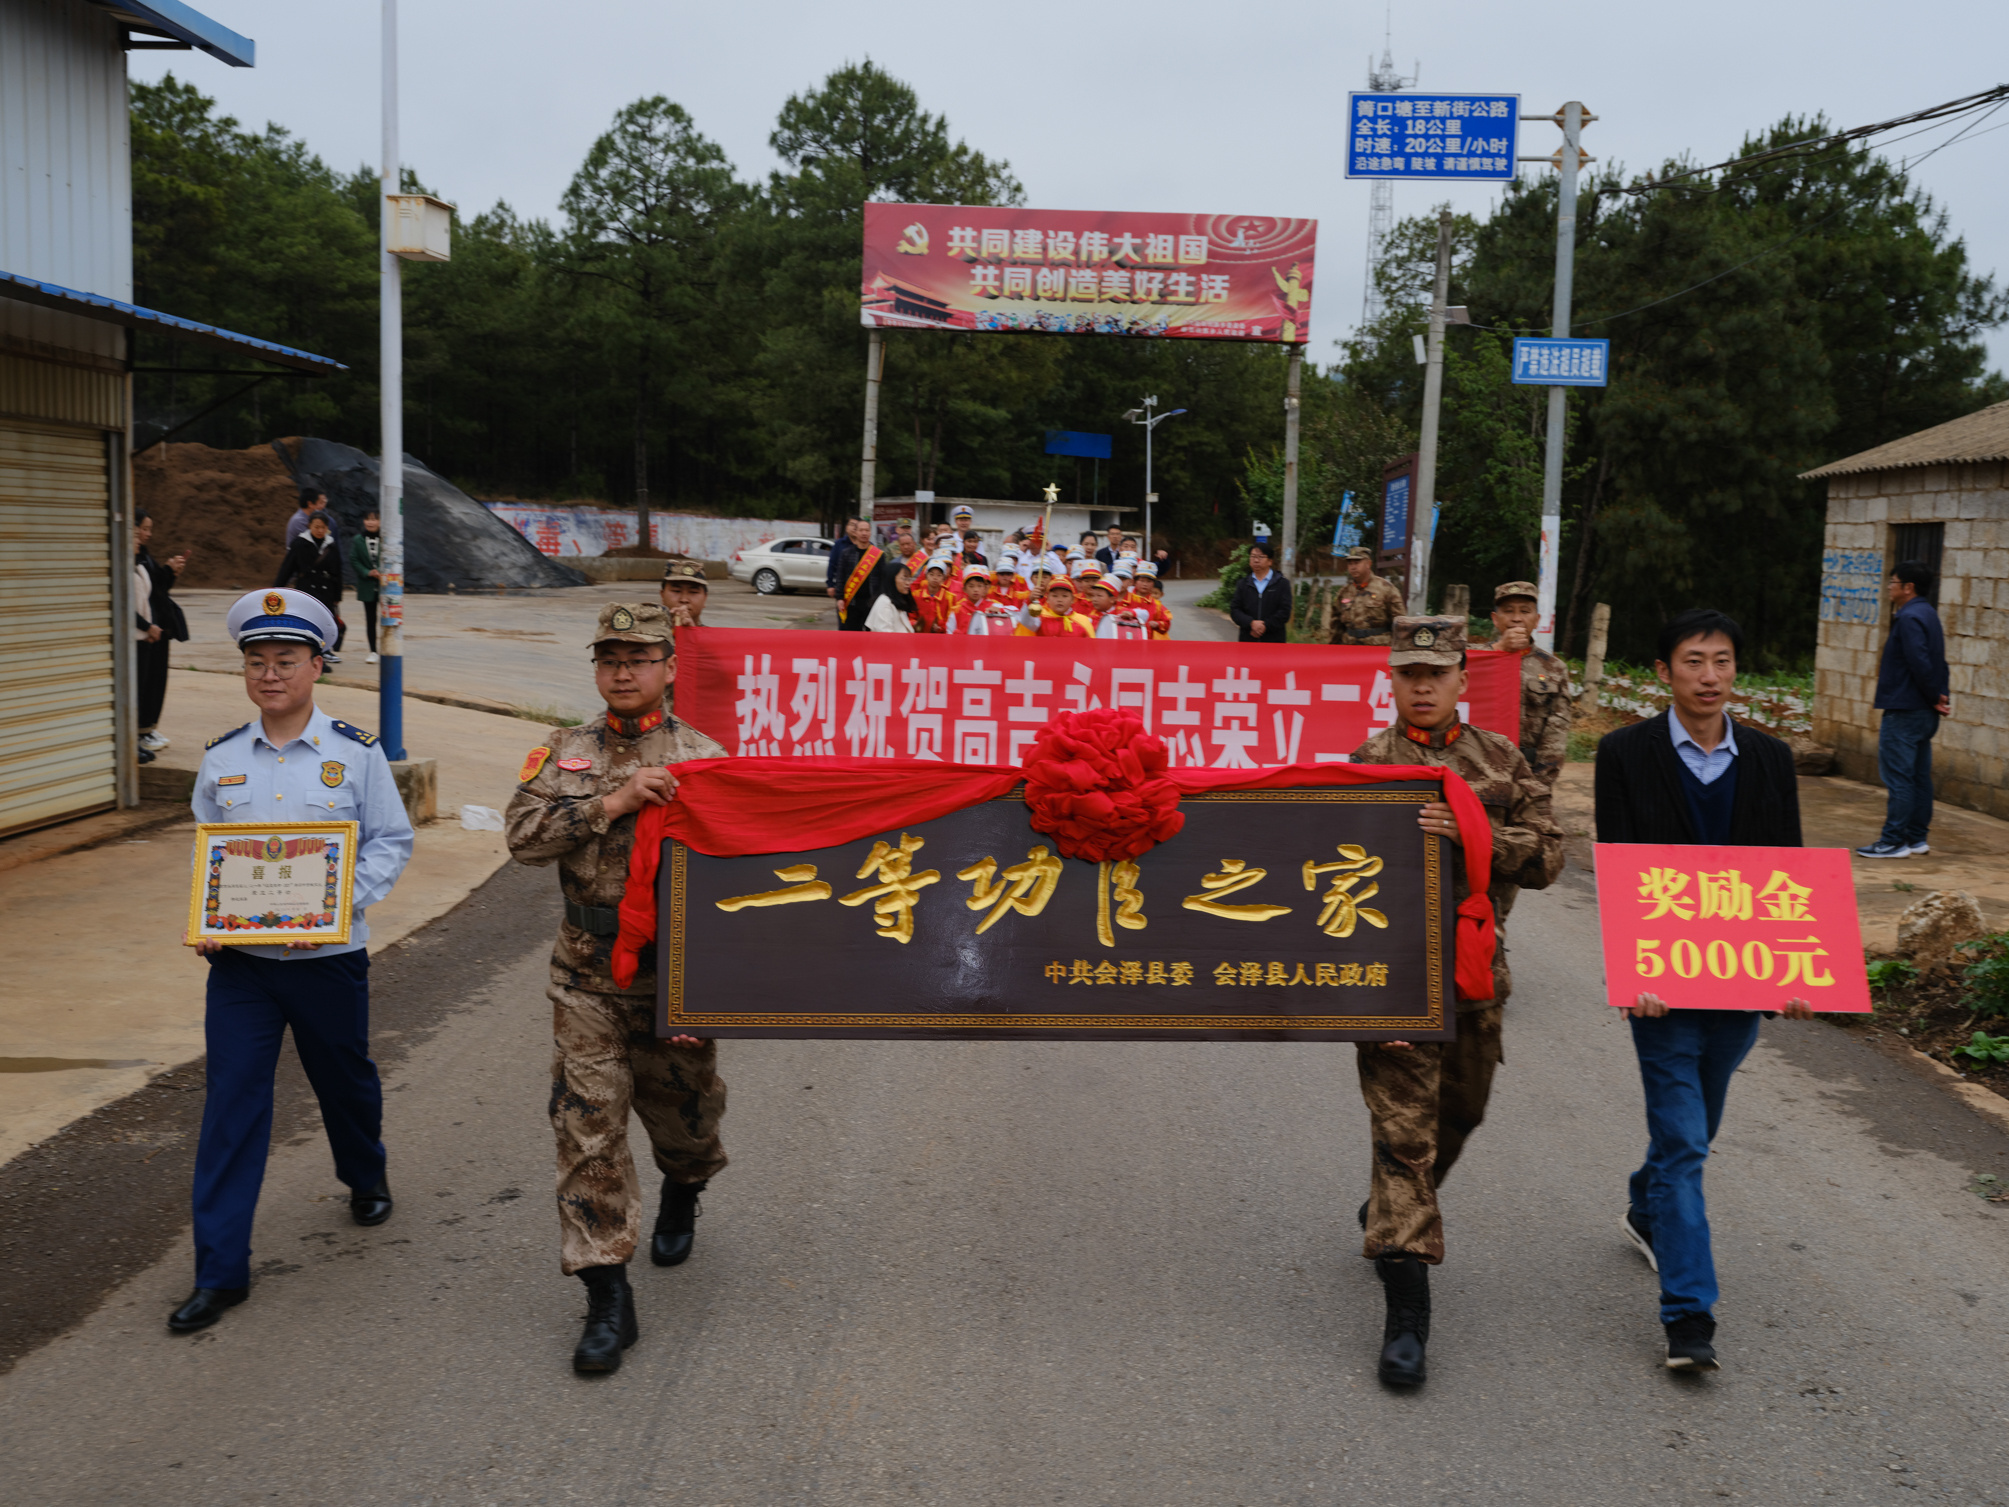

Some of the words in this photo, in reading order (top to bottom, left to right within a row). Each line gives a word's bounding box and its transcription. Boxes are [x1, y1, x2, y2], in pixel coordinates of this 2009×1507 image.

[947, 226, 1209, 265] 共同建设伟大祖国
[969, 264, 1231, 304] 共同创造美好生活
[735, 653, 1470, 768] 热烈祝贺高吉同志荣立二
[251, 864, 293, 880] 喜报
[716, 832, 1389, 947] 二等功臣之家
[1636, 867, 1818, 922] 奖励金
[1044, 959, 1195, 987] 中共会泽县委
[1213, 960, 1389, 988] 会泽县人民政府
[1635, 935, 1836, 987] 5000元
